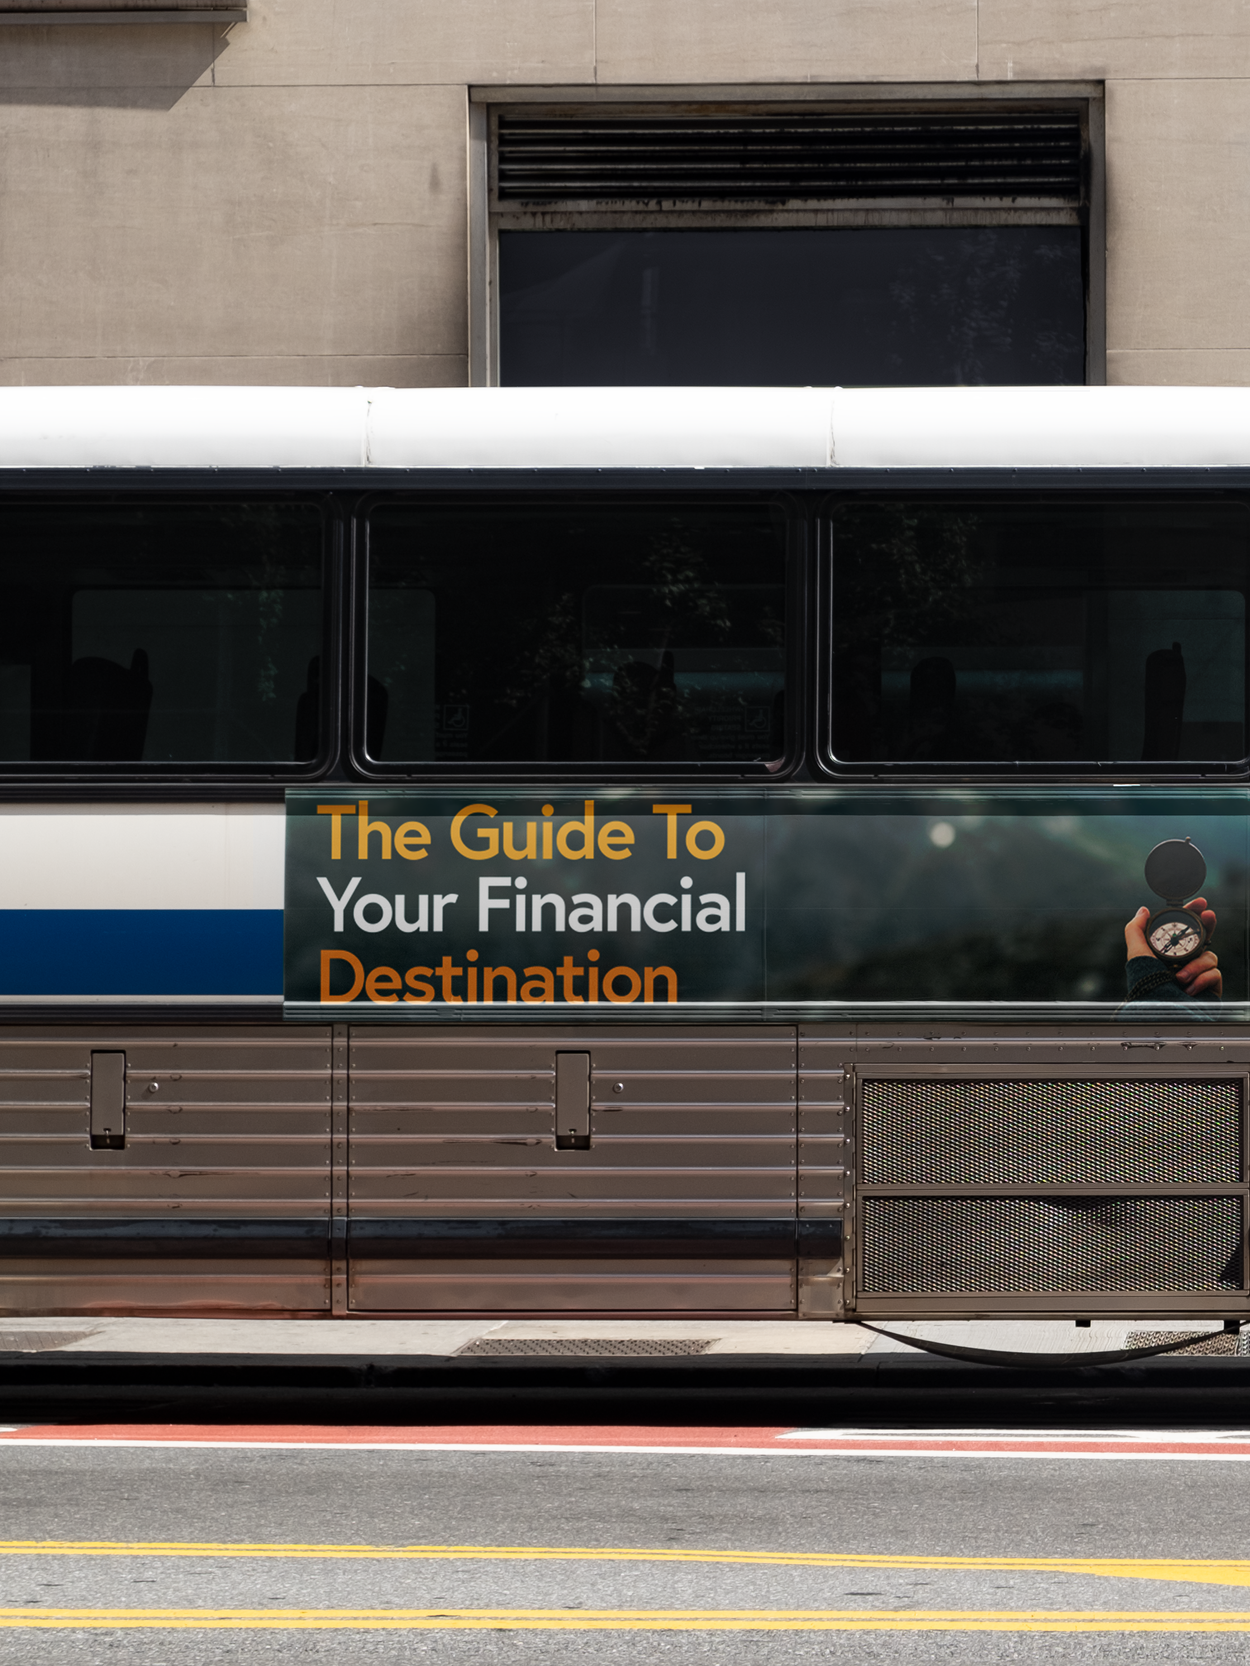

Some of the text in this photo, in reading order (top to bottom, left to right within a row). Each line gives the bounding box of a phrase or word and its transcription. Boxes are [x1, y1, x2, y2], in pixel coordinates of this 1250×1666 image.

[316, 800, 726, 861] The Guide To
[316, 871, 746, 933] Your Financial
[320, 948, 678, 1004] Destination
